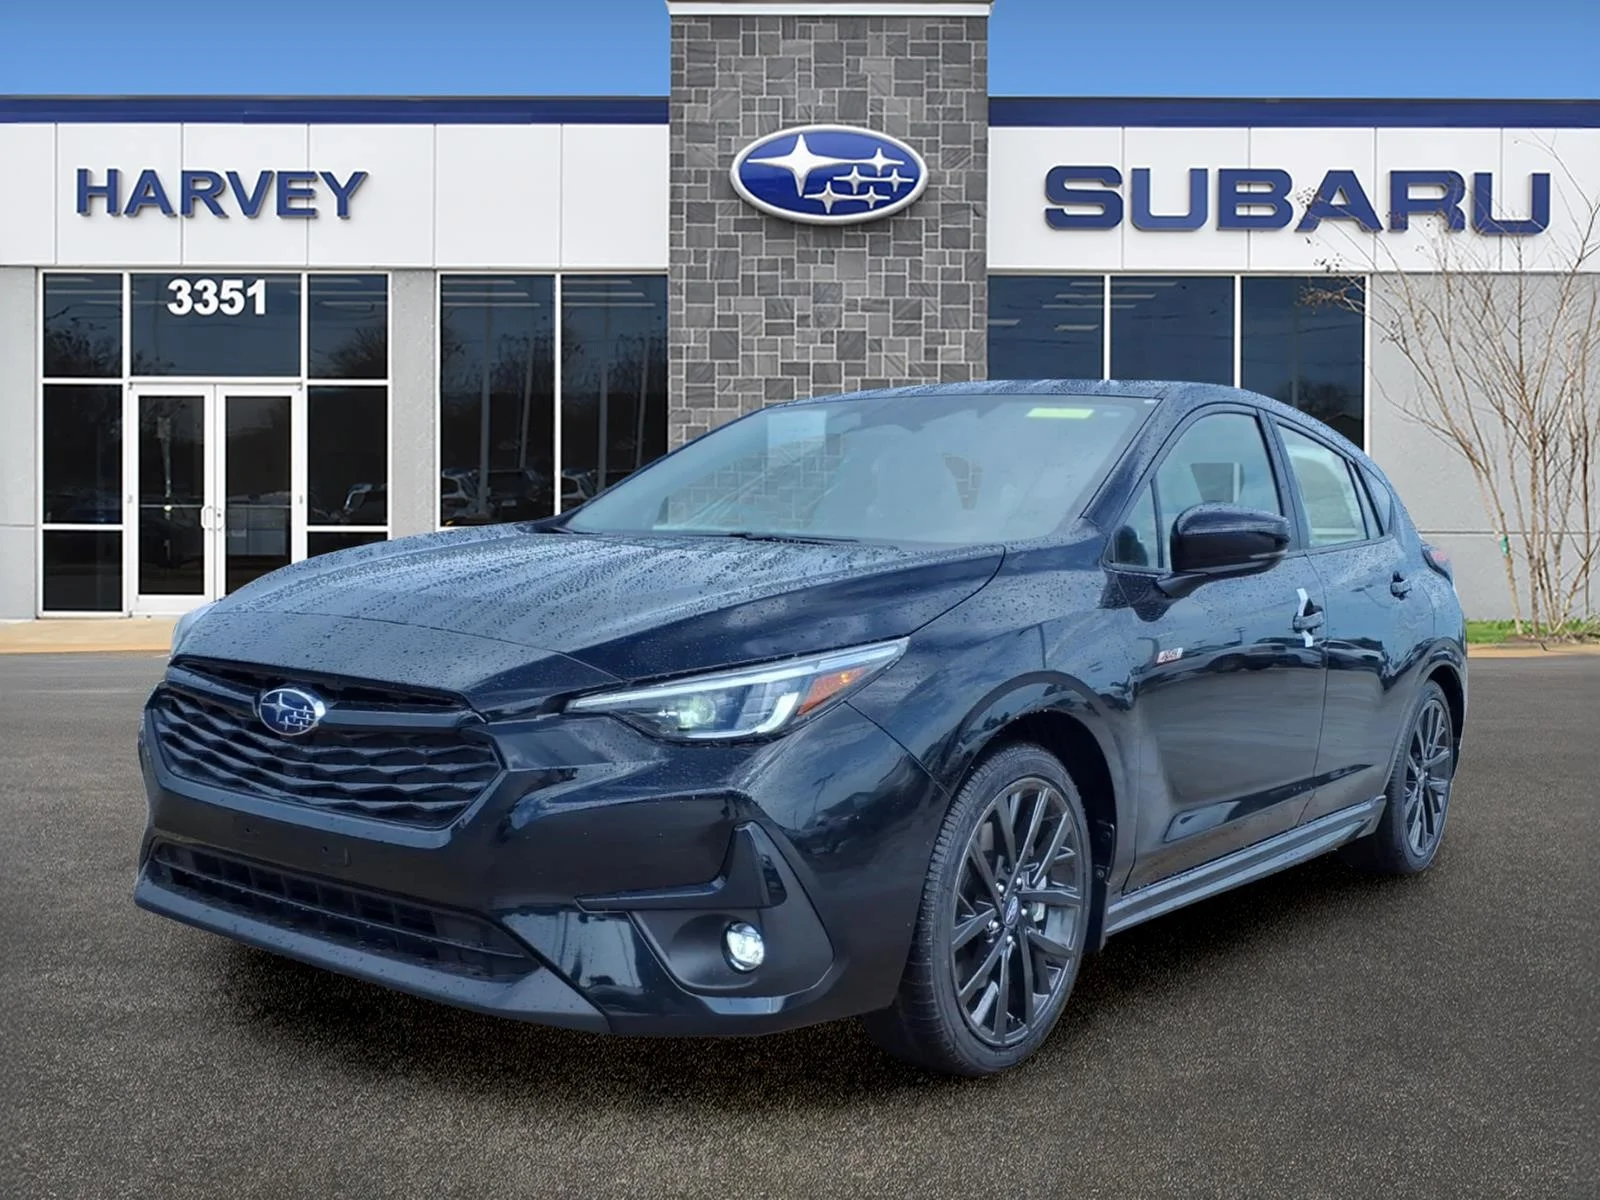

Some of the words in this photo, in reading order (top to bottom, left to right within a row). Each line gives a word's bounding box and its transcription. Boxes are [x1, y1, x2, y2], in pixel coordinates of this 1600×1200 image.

[76, 168, 368, 219] HARVEY
[1044, 165, 1551, 235] SUBARU
[166, 278, 266, 316] 3351
